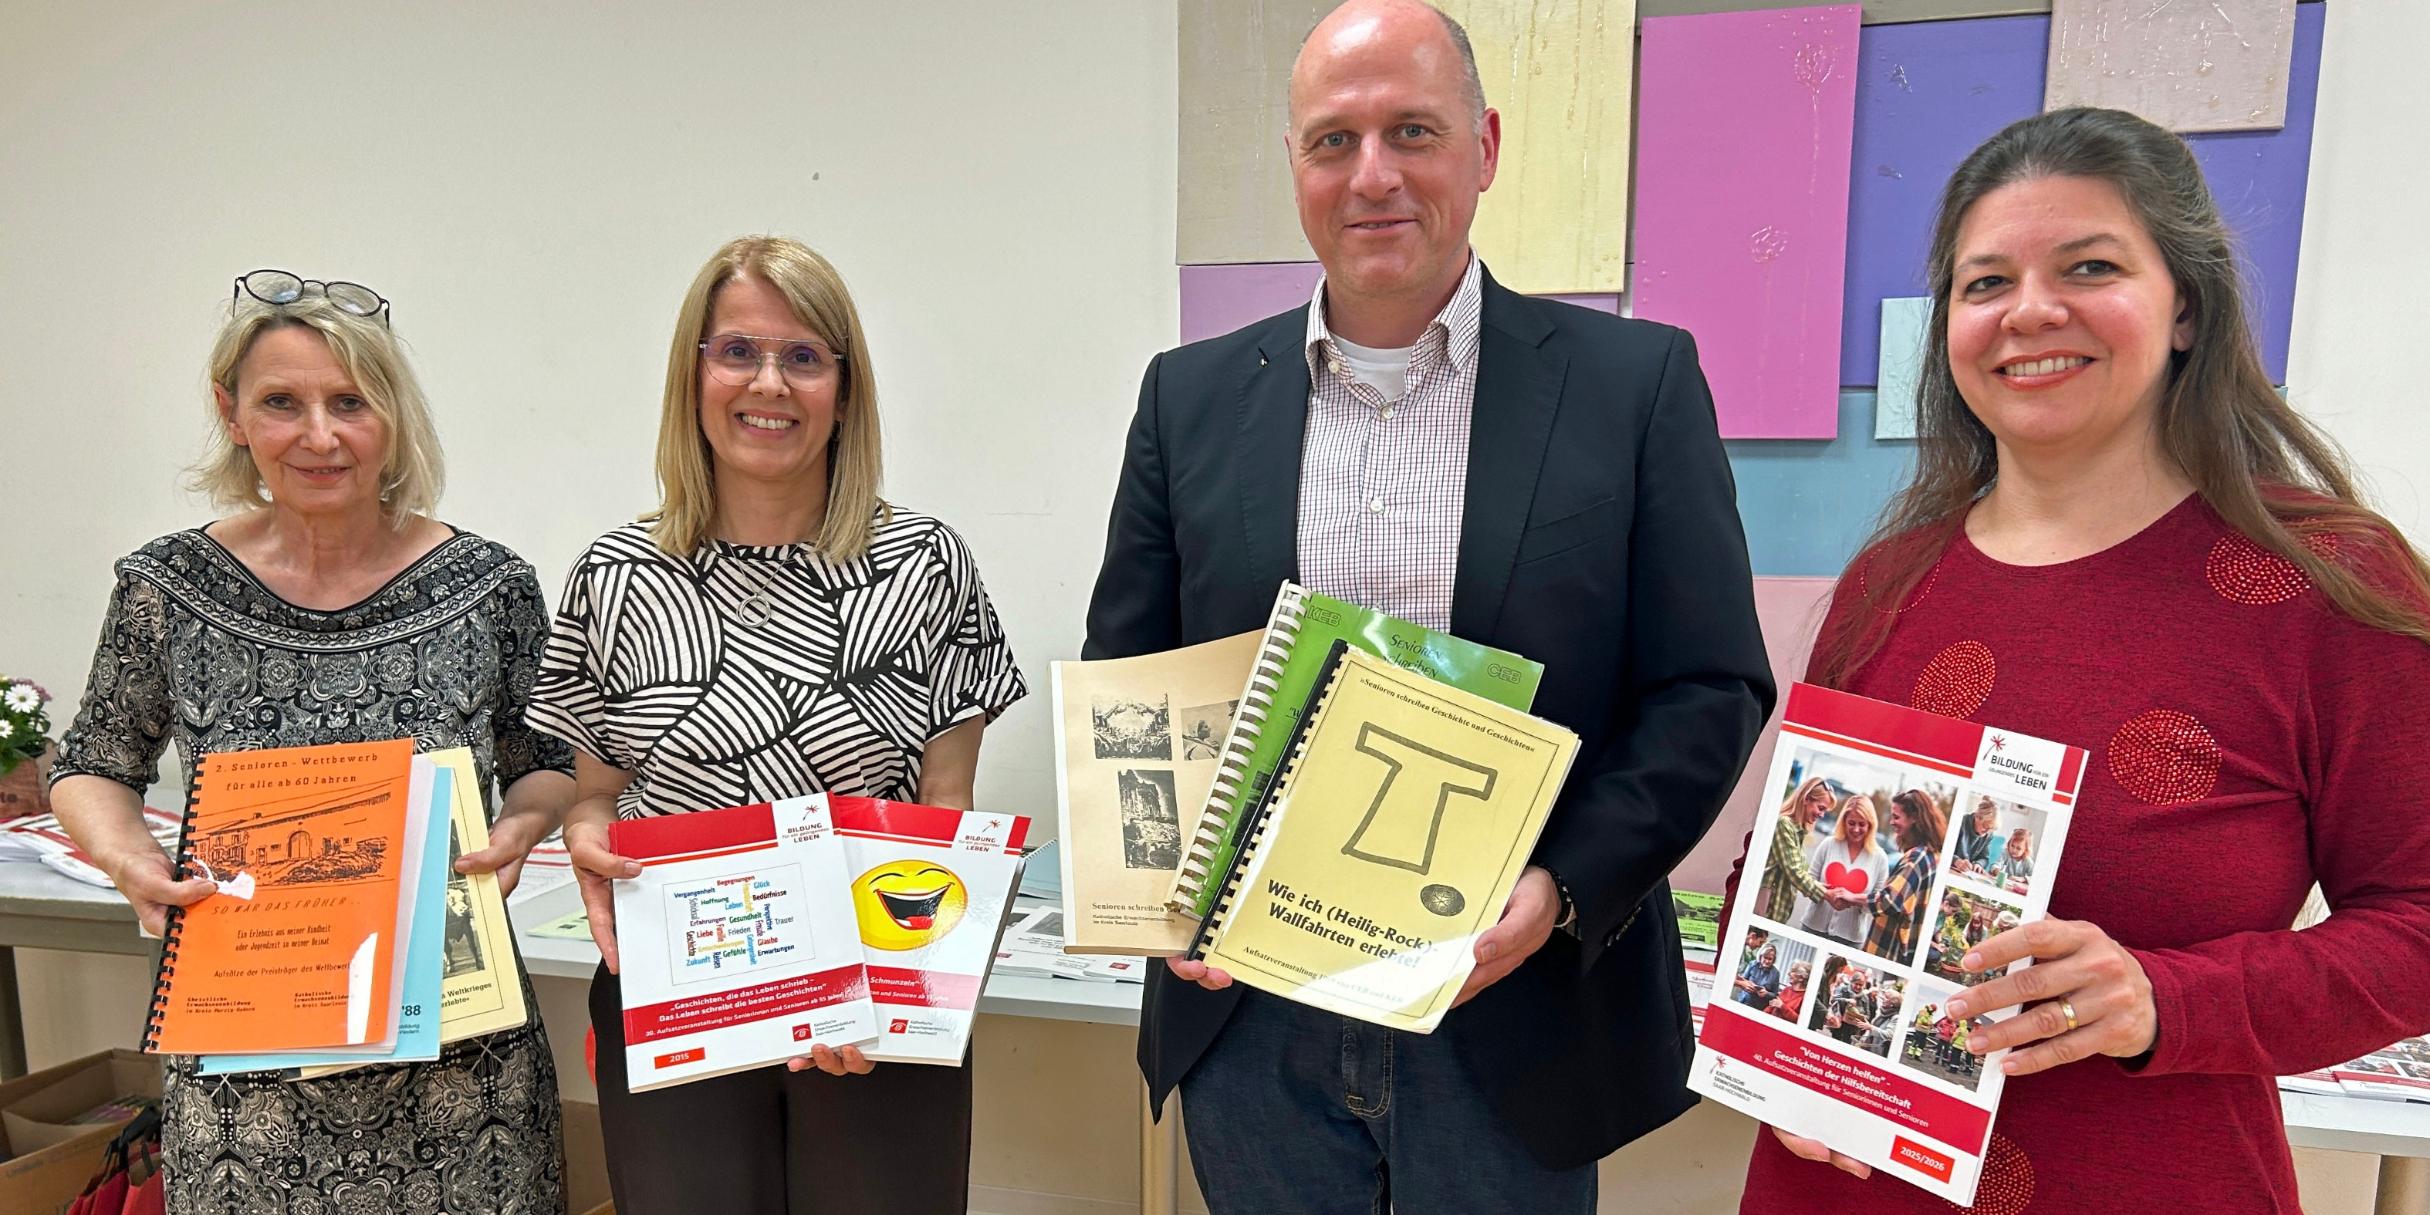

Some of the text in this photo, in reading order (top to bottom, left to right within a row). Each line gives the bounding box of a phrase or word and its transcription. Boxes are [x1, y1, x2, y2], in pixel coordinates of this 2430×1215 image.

[1307, 605, 1342, 627] KEB
[1487, 663, 1522, 684] CEB
[1396, 693, 1431, 711] schreiben
[1431, 706, 1470, 727] Geschichte
[1471, 723, 1486, 733] und
[216, 764, 226, 773] 2.
[231, 760, 289, 772] Senioren
[301, 753, 379, 766] Wettbewerb
[1991, 754, 2034, 774] BILDUNG
[226, 774, 357, 791] für alle ab 60 Jahren
[2015, 774, 2047, 790] LEBEN
[787, 823, 823, 834] BILDUNG
[793, 834, 820, 843] LEBEN
[965, 835, 997, 843] BILDUNG
[753, 880, 770, 889] Glück
[674, 888, 715, 898] Vergangenheit
[752, 890, 787, 902] Bedürfnisse
[1268, 879, 1296, 903] Wie
[1299, 894, 1323, 914] ich
[701, 896, 729, 905] Hoffnung
[725, 902, 743, 910] Leben
[234, 904, 258, 913] WAR
[265, 901, 289, 912] DAS
[1128, 904, 1164, 912] schreiben
[690, 916, 726, 927] Erfahrungen
[729, 912, 762, 924] Gesundheit
[775, 916, 794, 925] Trauer
[728, 926, 751, 936] Frieden
[1269, 902, 1355, 948] Wallfahrten
[249, 929, 273, 938] Erlebnis
[696, 930, 713, 938] Liebe
[757, 937, 778, 946] Glaube
[722, 948, 747, 958] Gefühle
[757, 945, 795, 957] Erwartungen
[686, 956, 711, 967] Zukunft
[1243, 946, 1318, 980] Aufsatzveranstaltung
[246, 969, 258, 977] der
[300, 965, 313, 973] des
[447, 983, 492, 998] Weltkrieges
[726, 992, 739, 1000] die
[740, 990, 754, 998] das
[755, 983, 779, 994] Leben
[781, 978, 809, 990] schrieb
[401, 1004, 422, 1016] '88
[659, 1013, 674, 1022] Das
[676, 1009, 700, 1019] Leben
[701, 1004, 733, 1014] schreibt
[734, 1000, 747, 1008] die
[749, 995, 775, 1005] besten
[669, 1052, 690, 1063] 2015
[1822, 1055, 1852, 1072] Herzen
[1774, 1050, 1912, 1110] Geschichten der Hilfsbereitschaft
[1764, 1059, 1831, 1091] Aufsatzveranstaltung
[1831, 1084, 1843, 1093] für
[1884, 1105, 1898, 1115] und
[1898, 1110, 1929, 1128] Senioren
[1900, 1146, 1946, 1172] 2025/2026
